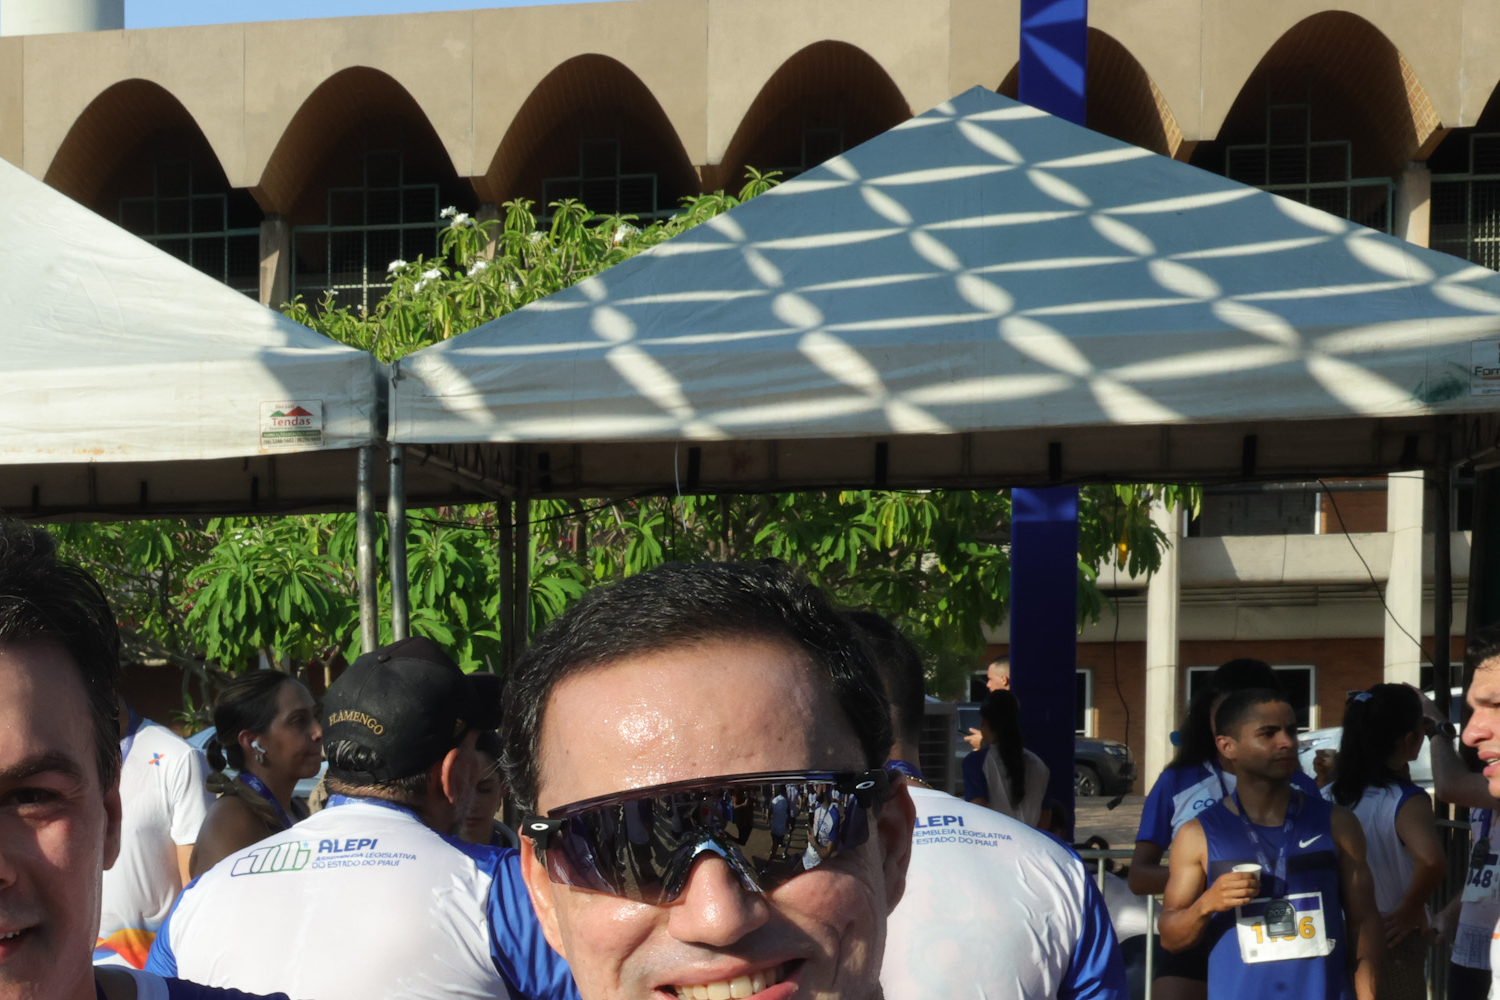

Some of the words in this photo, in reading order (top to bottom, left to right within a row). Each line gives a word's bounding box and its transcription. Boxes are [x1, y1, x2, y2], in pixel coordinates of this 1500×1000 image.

[272, 416, 312, 427] Tendas
[328, 709, 384, 735] FLAMENGO
[915, 815, 965, 828] LEPI
[916, 836, 956, 845] ESTADO
[958, 836, 973, 845] DO
[958, 829, 1013, 841] LEGISLATIVA
[318, 838, 379, 853] ALEPI
[365, 851, 417, 861] LEGISLATIVA
[311, 861, 326, 869] DO
[327, 859, 361, 869] ESTADO
[361, 859, 377, 867] DO
[1251, 916, 1316, 944] 16
